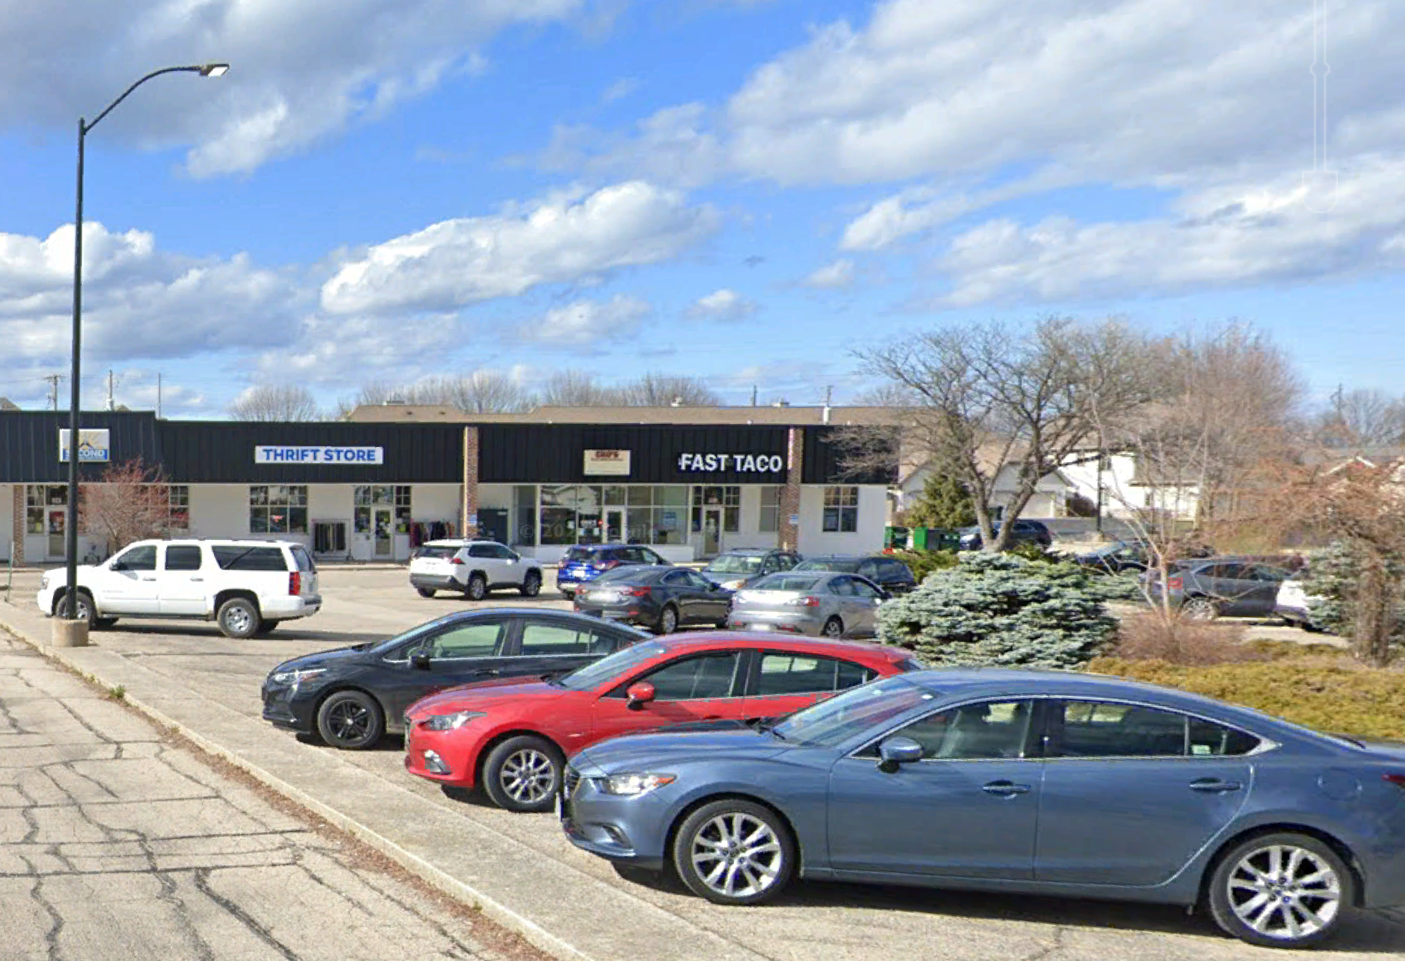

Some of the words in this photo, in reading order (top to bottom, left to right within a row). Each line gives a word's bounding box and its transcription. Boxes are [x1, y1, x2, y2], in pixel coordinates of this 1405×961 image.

[63, 449, 105, 458] SCOND
[262, 448, 320, 461] THRIFT
[324, 448, 376, 461] STORE
[680, 453, 729, 471] FAST
[733, 454, 783, 473] TACO
